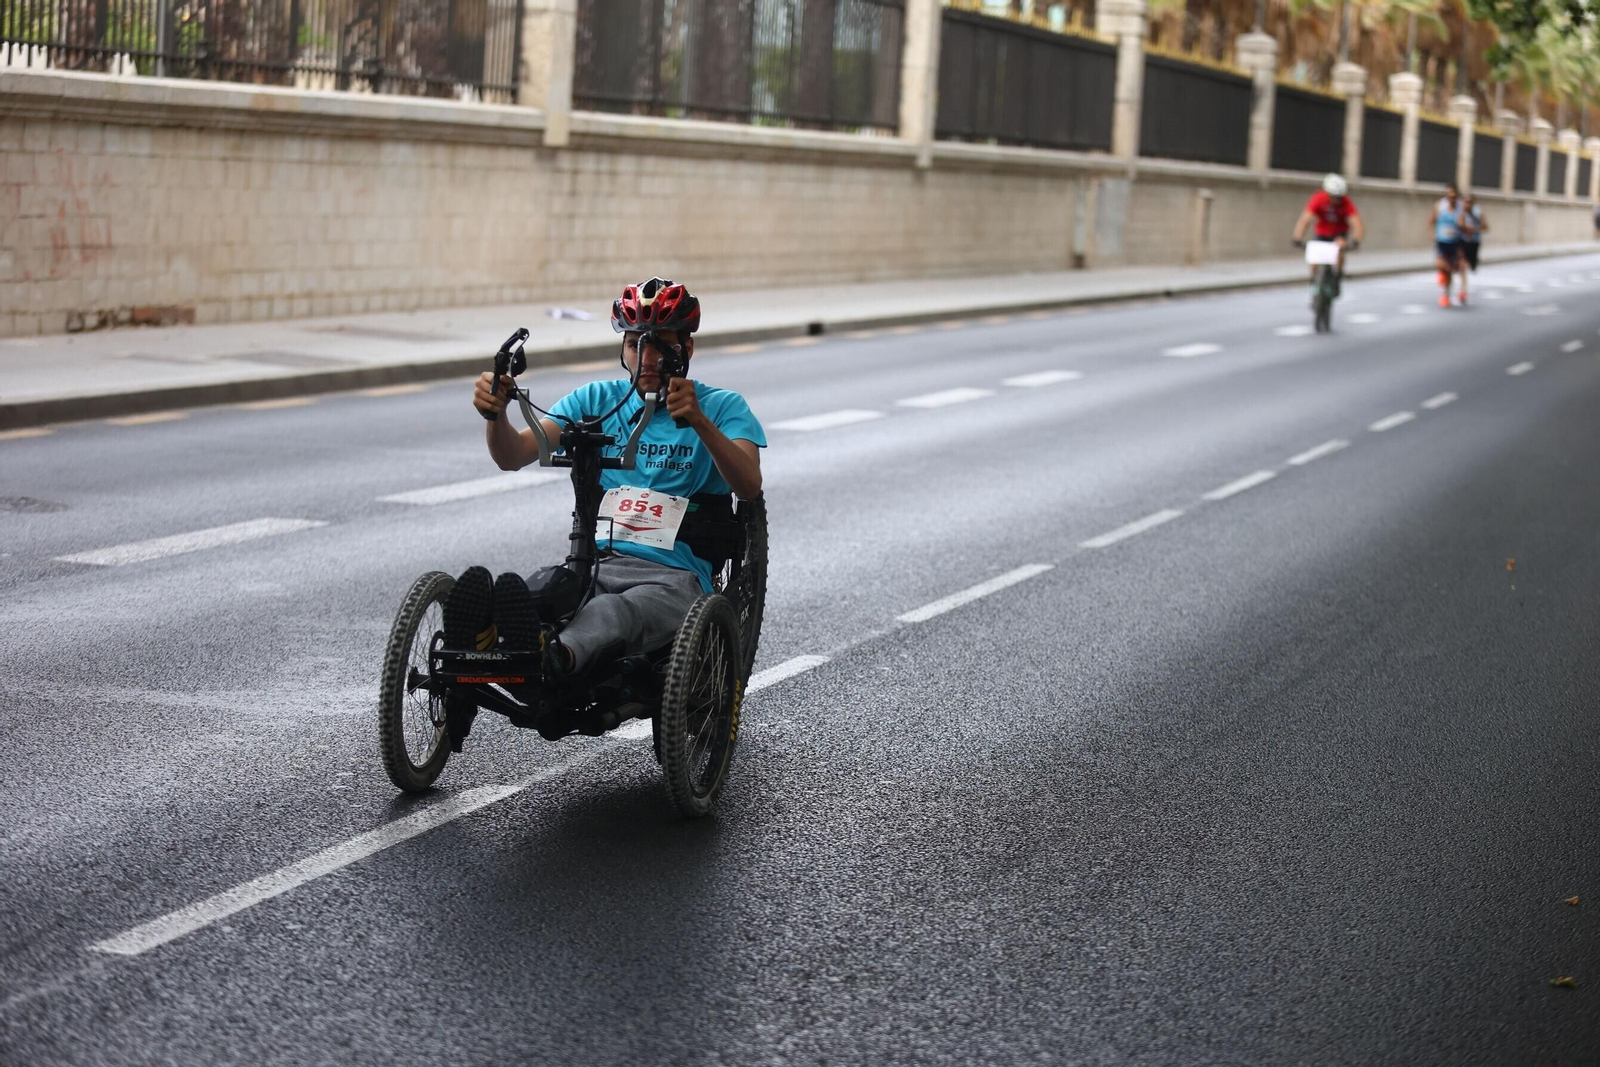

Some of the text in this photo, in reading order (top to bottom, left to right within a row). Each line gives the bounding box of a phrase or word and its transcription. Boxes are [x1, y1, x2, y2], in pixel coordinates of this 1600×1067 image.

[645, 457, 693, 471] málaga
[618, 499, 663, 517] 854
[730, 678, 741, 742] MAXXIS
